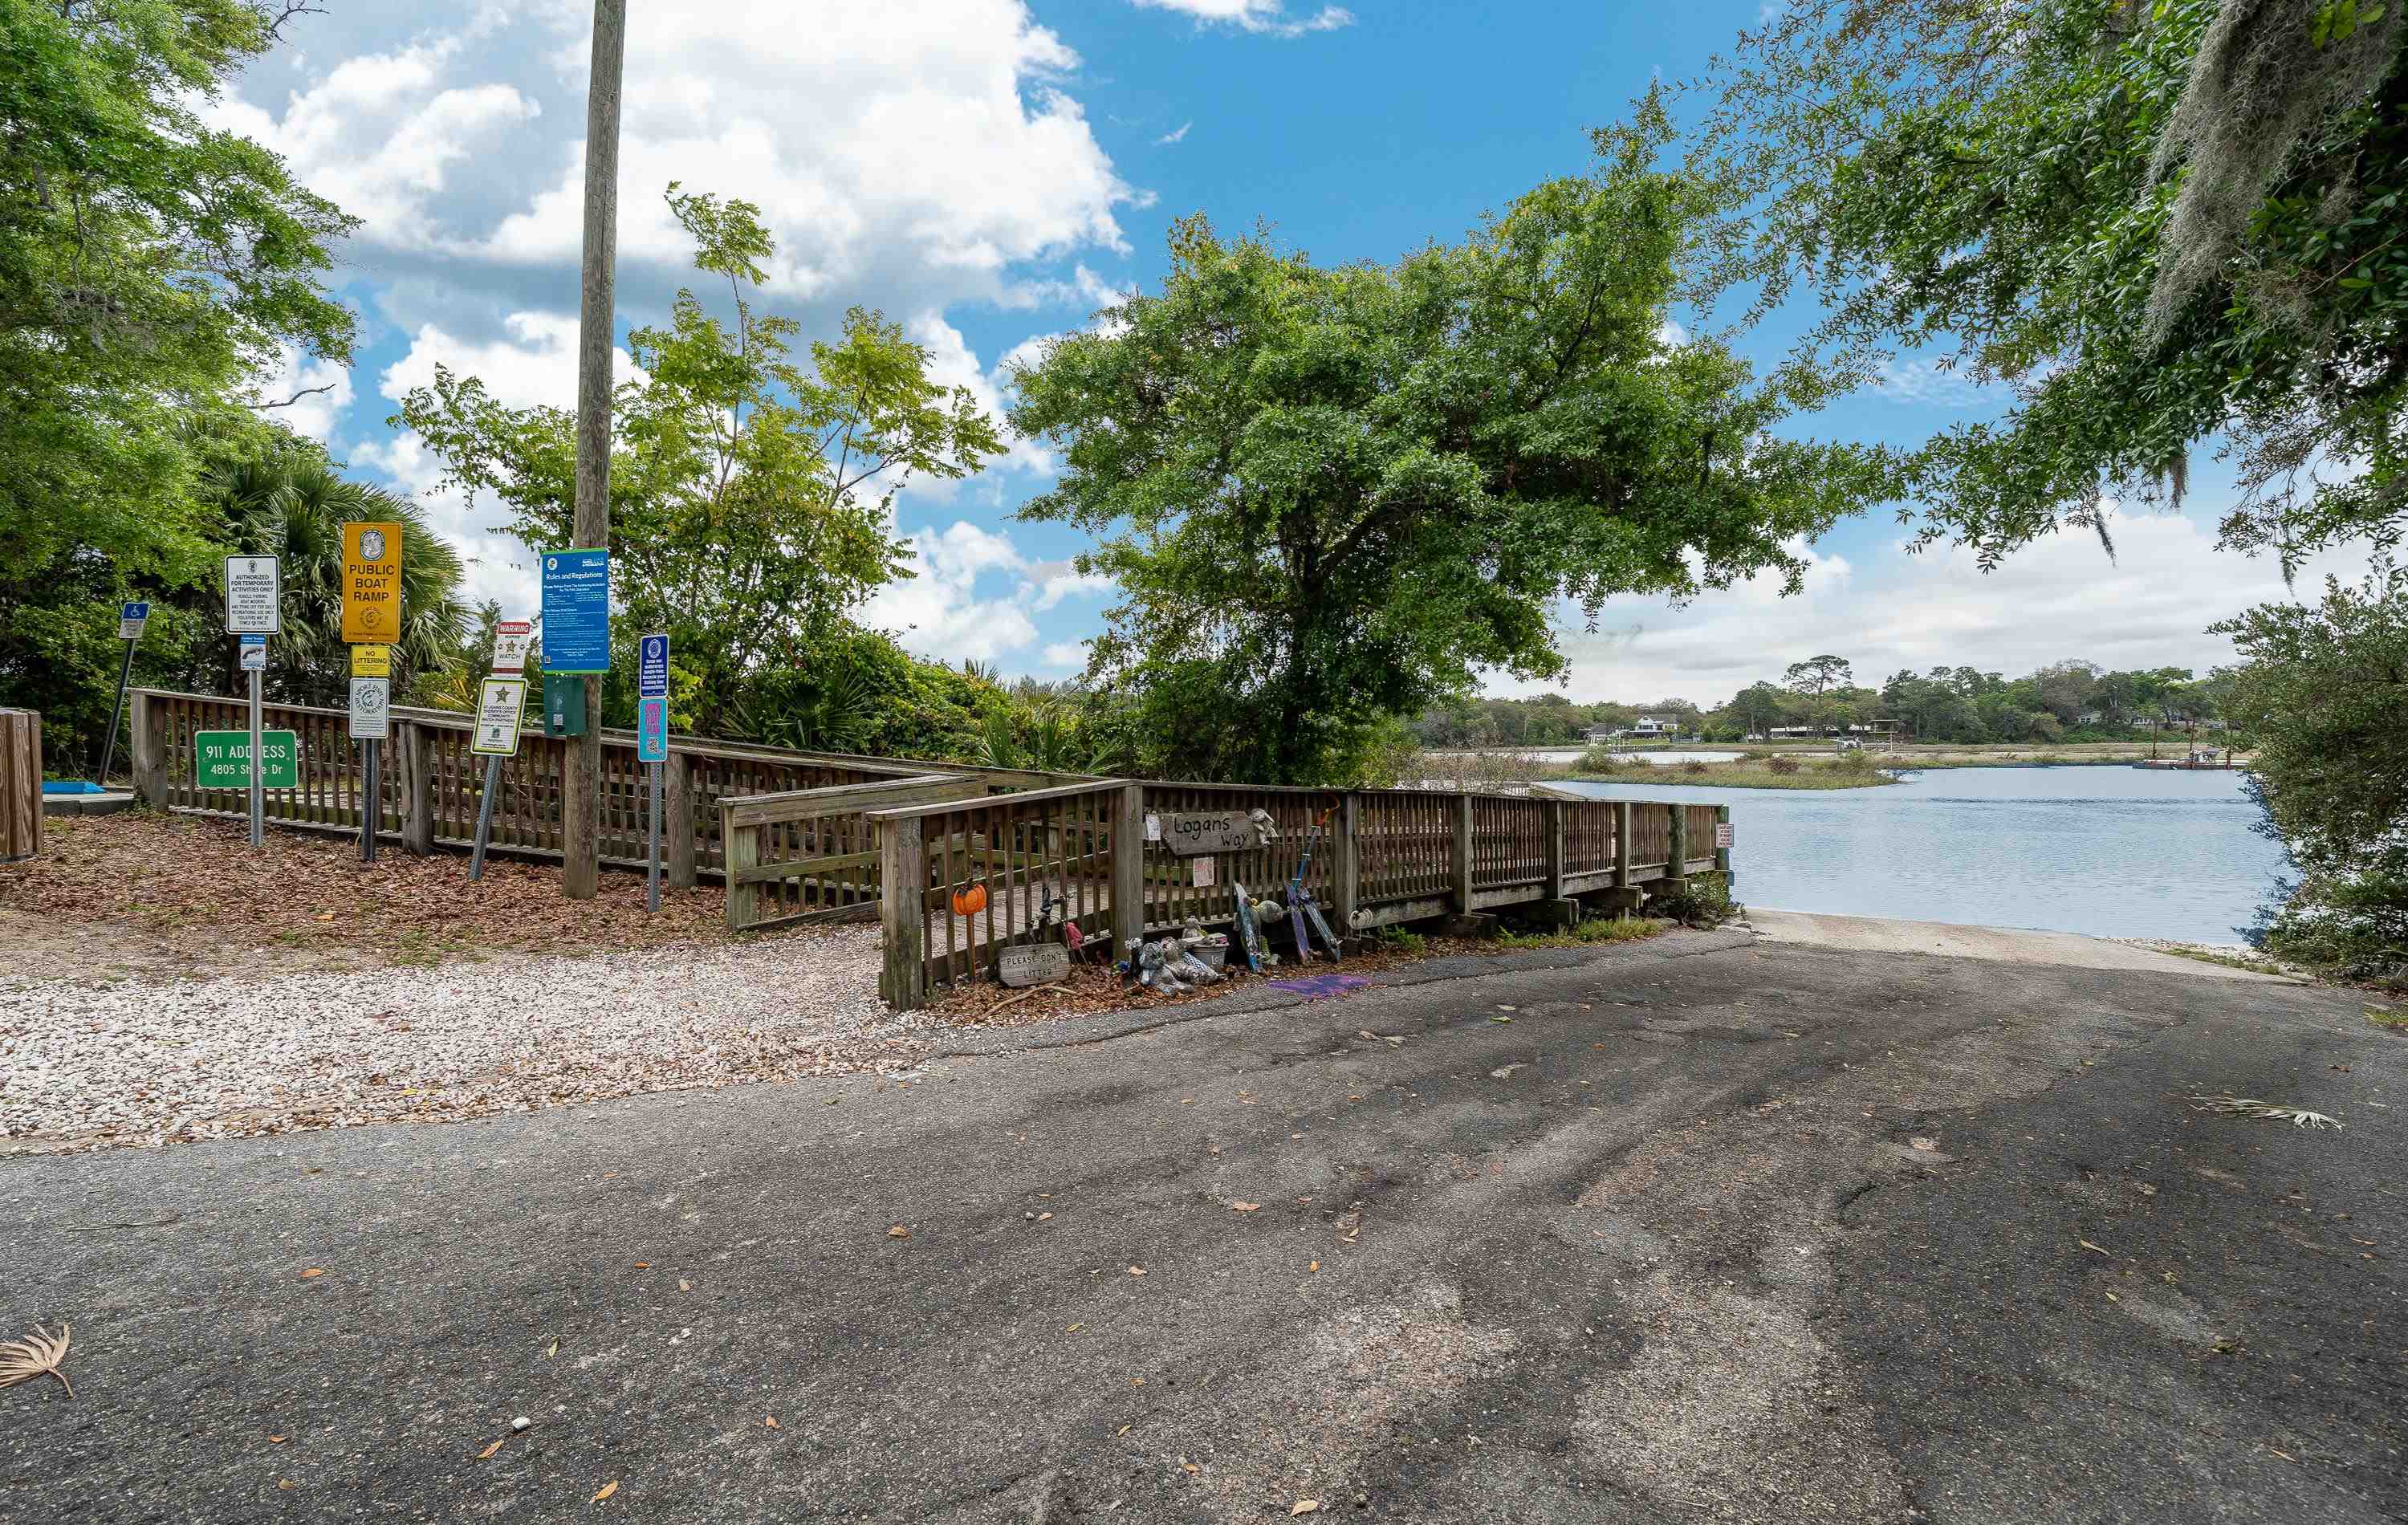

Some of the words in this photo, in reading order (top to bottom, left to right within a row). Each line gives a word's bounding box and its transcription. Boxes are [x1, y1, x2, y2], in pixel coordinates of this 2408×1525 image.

[349, 564, 395, 575] PUBLIC
[571, 571, 604, 580] Regulations
[355, 577, 389, 588] BOAT
[354, 591, 390, 602] RAMP
[500, 624, 529, 632] WARNING
[205, 745, 222, 758] 911
[228, 745, 286, 758] ADDESS
[210, 764, 235, 775] 4805
[240, 764, 267, 775] She
[271, 764, 283, 775] Dr
[1173, 817, 1230, 840] Logans
[1007, 955, 1037, 965] PLEASE
[1041, 951, 1062, 963] DON'T
